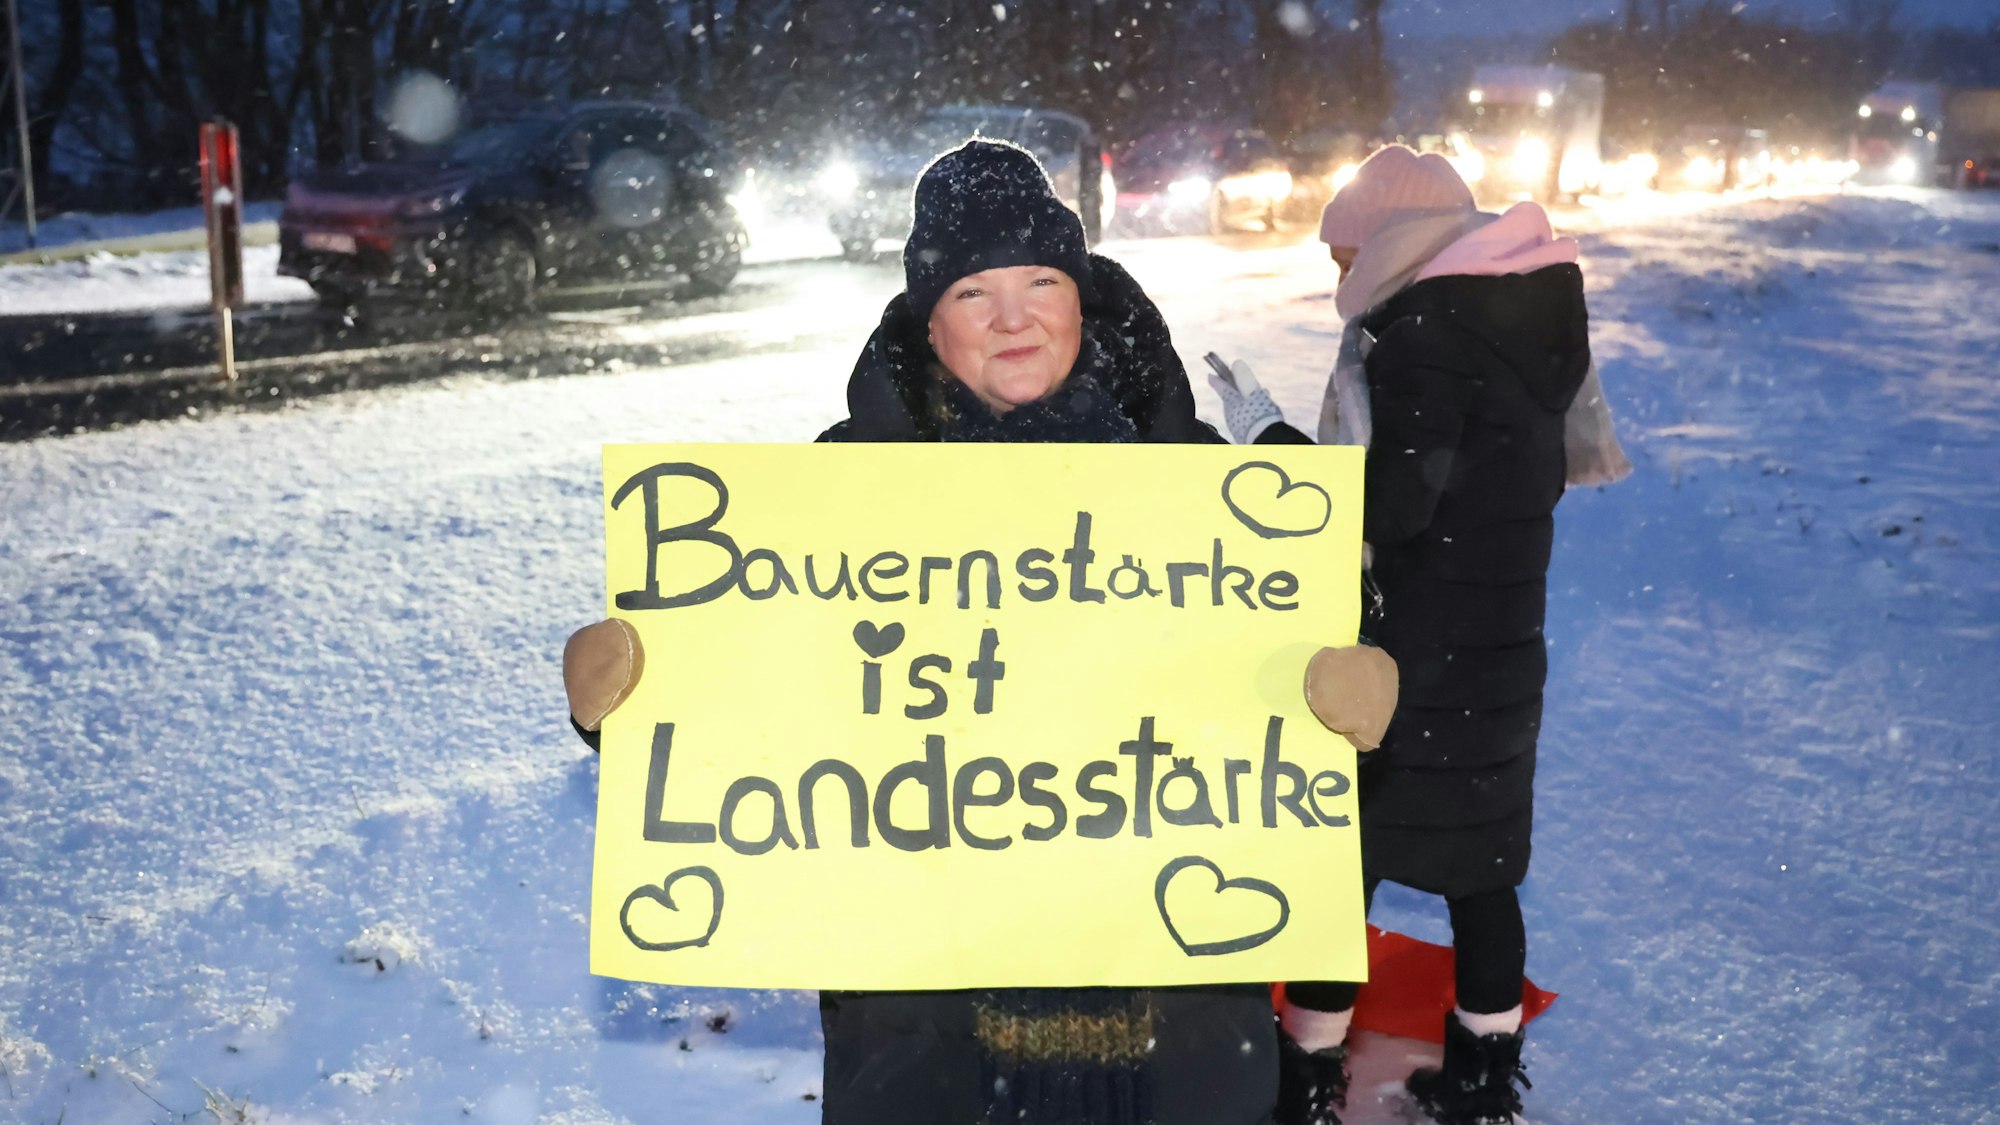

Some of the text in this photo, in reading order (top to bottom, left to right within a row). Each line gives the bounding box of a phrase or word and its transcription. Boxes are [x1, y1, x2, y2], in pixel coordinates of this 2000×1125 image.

[611, 463, 1299, 611] Bauernstärke
[853, 621, 1005, 720] ist
[643, 716, 1351, 856] Landesstärke
